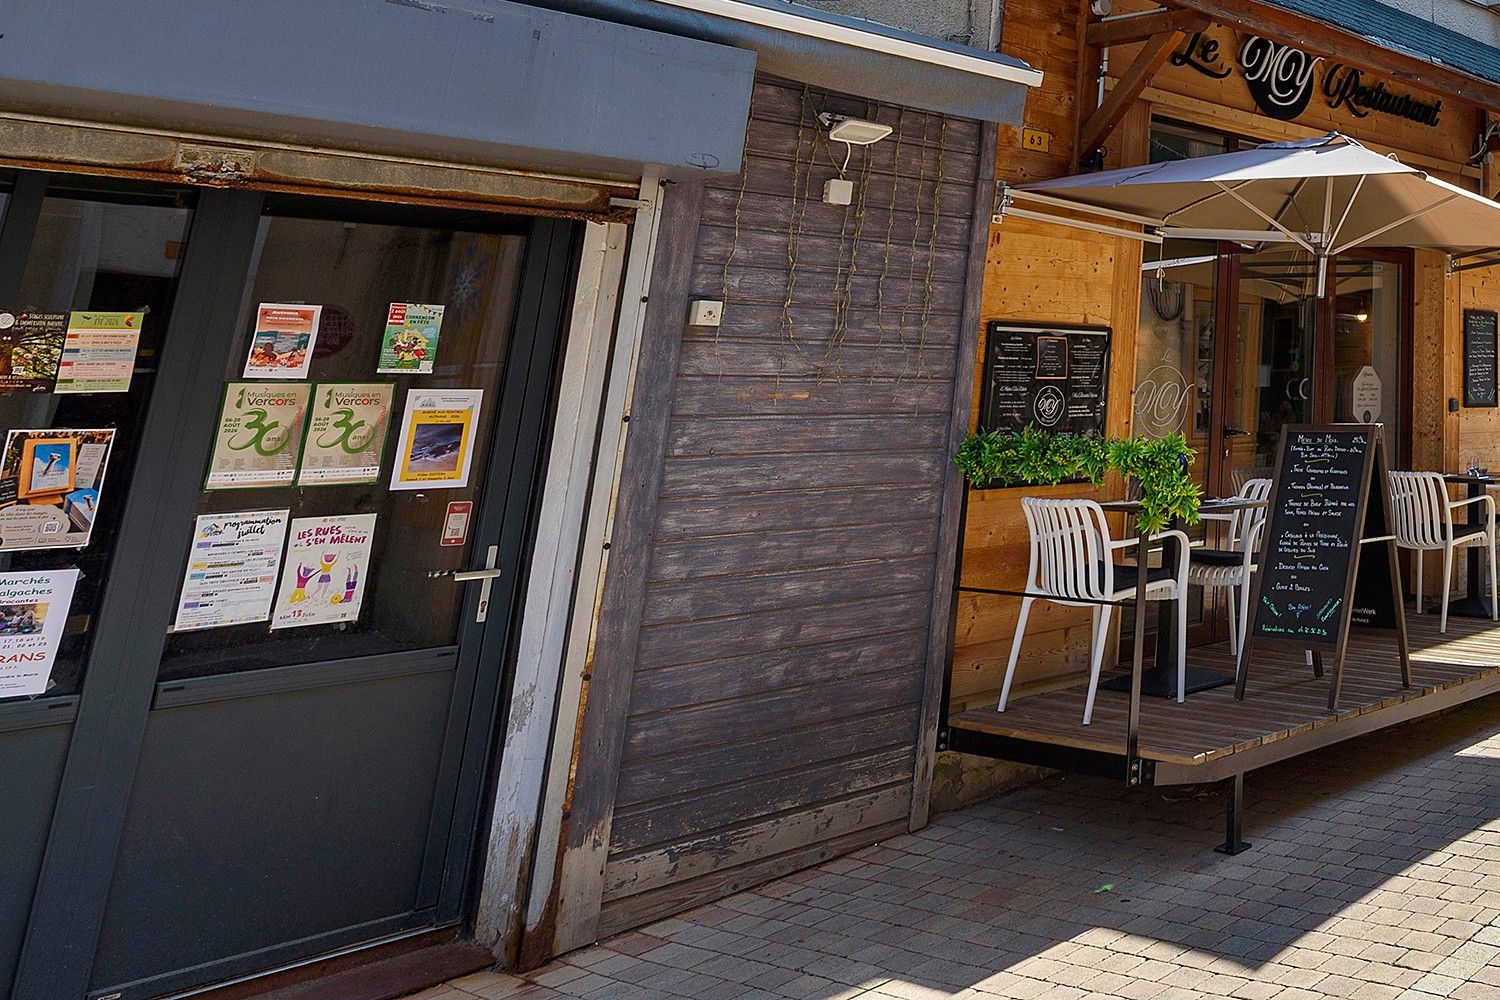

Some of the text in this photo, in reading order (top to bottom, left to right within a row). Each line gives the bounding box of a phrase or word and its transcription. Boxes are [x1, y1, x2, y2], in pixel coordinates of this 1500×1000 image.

[1171, 32, 1233, 79] Le
[1323, 63, 1443, 127] Restaurant
[1030, 135, 1042, 146] 63
[247, 389, 285, 398] Musiques
[334, 389, 371, 398] Musiques
[247, 397, 296, 406] Vercors
[336, 397, 380, 406] Vercors
[224, 516, 282, 530] programmation
[298, 529, 312, 540] LES
[315, 526, 342, 537] RUES
[306, 533, 368, 547] S'EN MÊLENT
